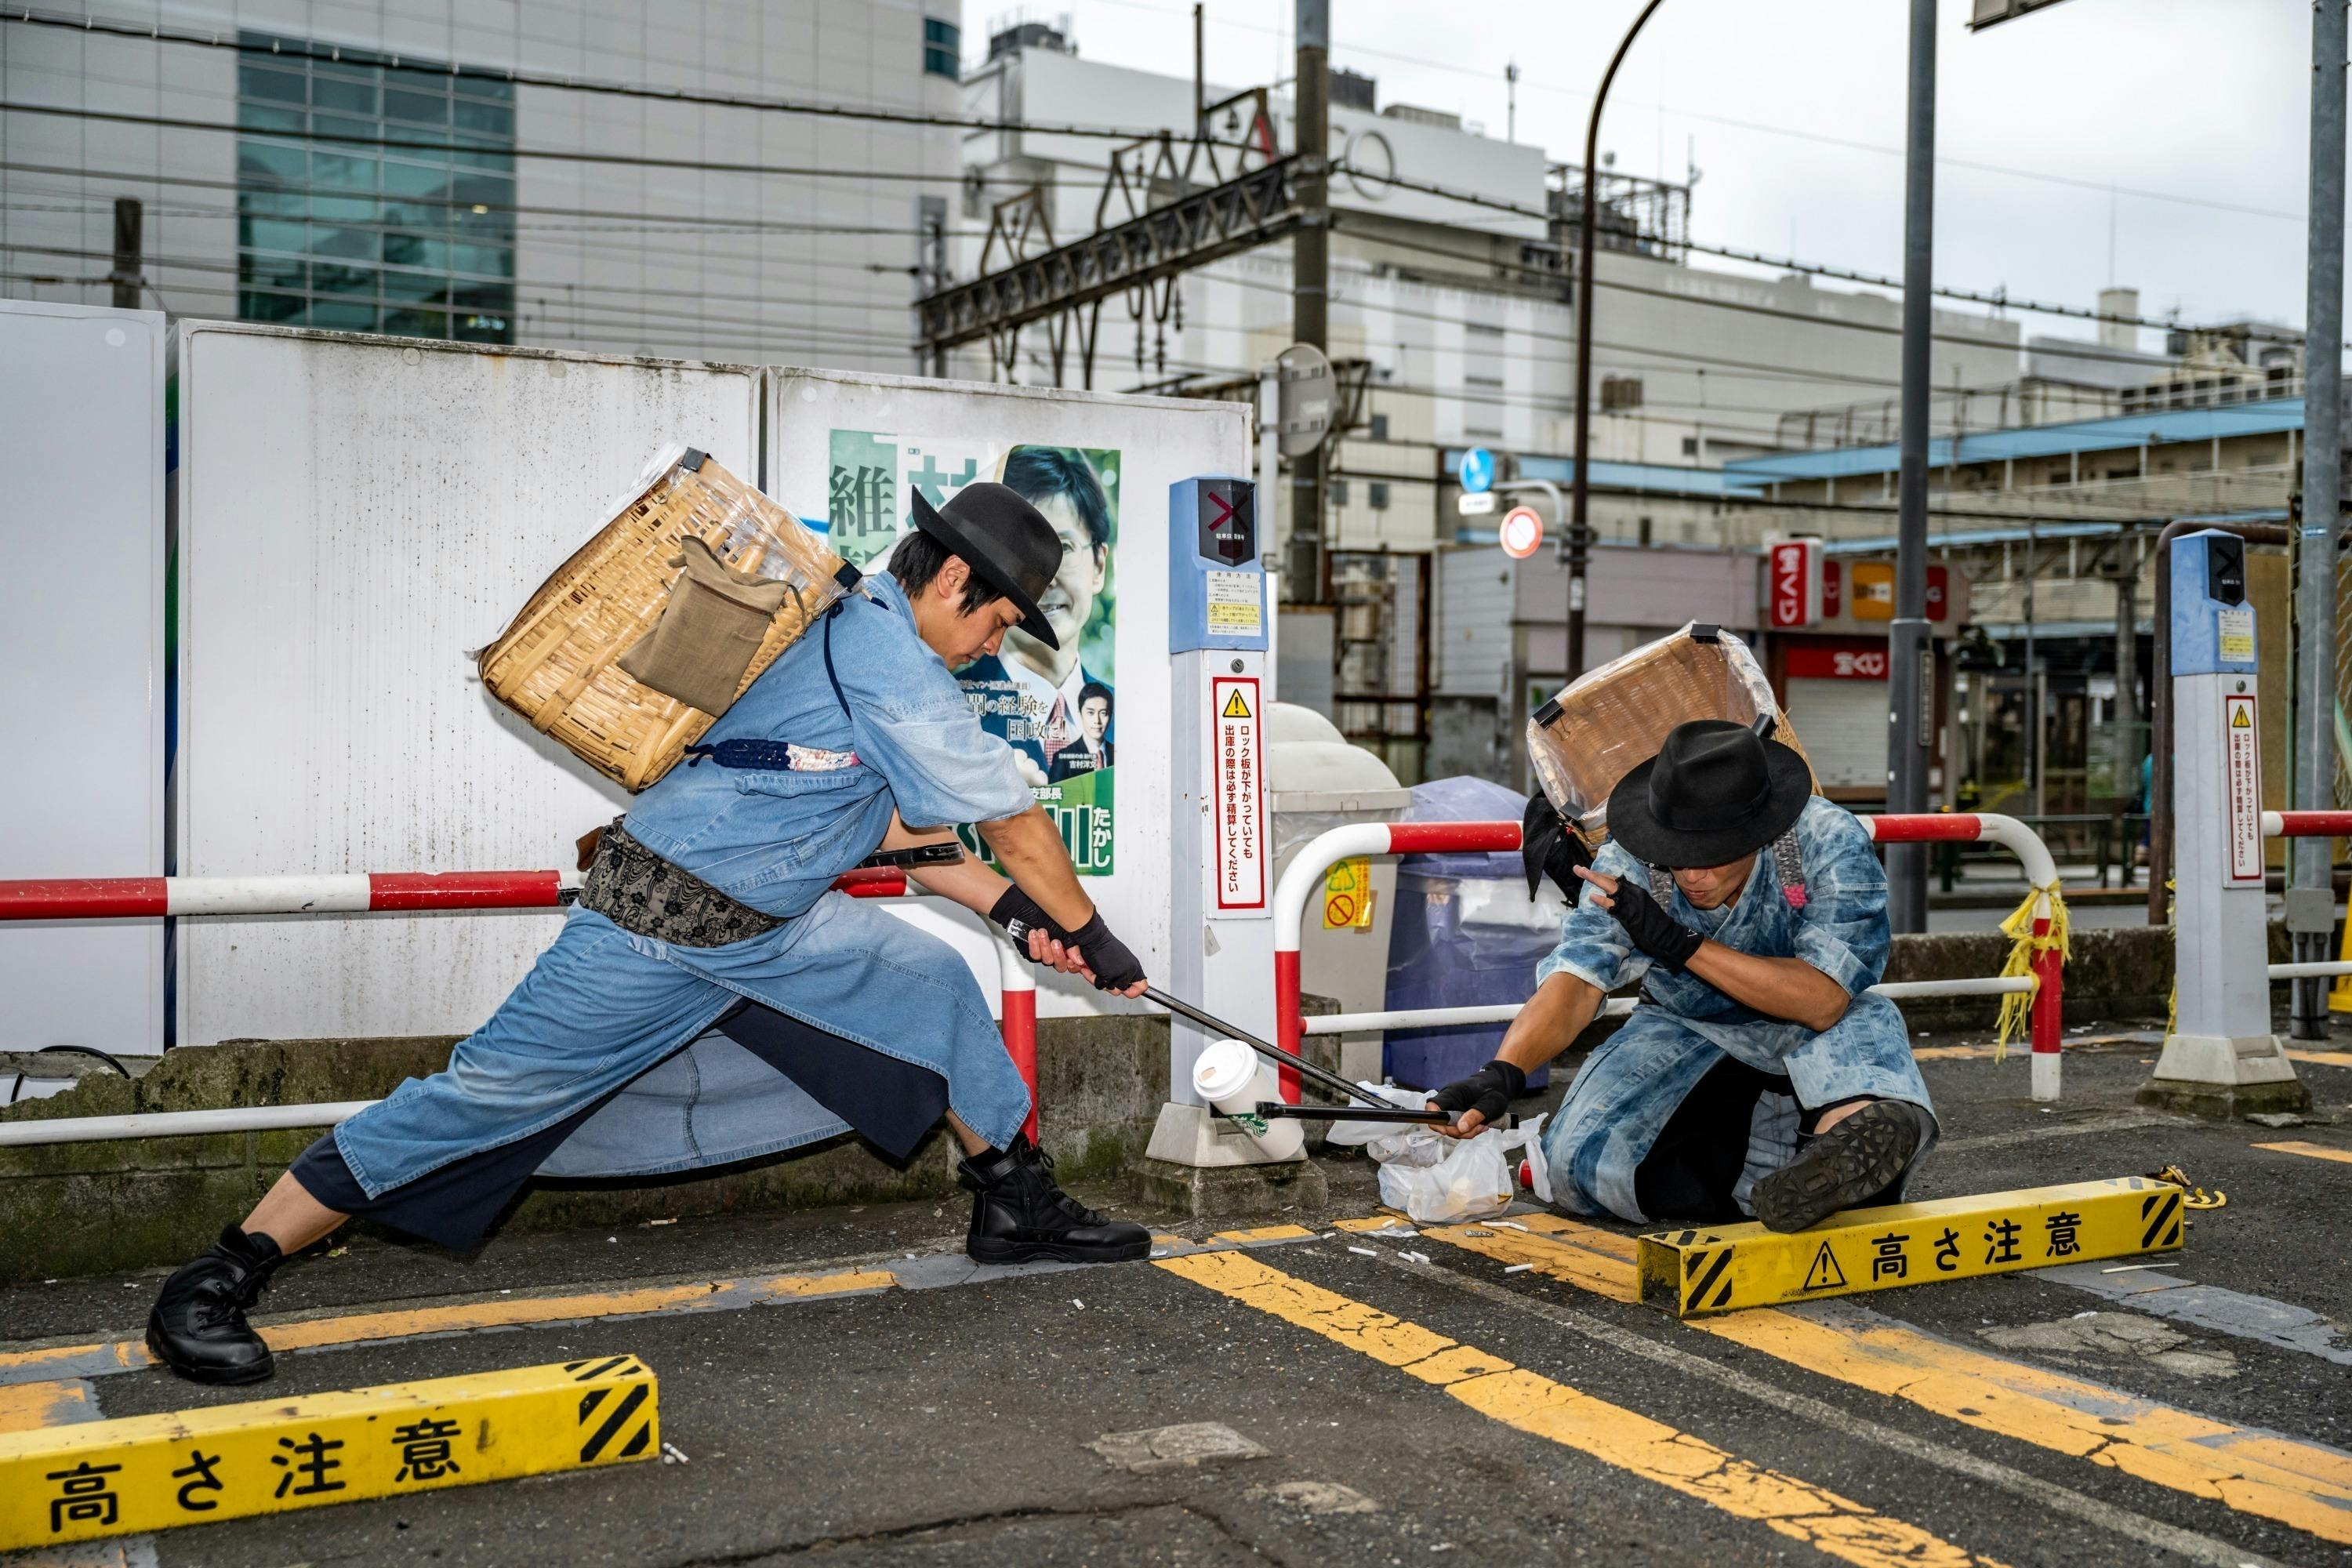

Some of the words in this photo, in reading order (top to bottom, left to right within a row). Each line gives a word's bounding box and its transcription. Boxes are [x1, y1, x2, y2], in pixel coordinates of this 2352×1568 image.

[1833, 652, 1884, 676] 宝くじ
[1092, 807, 1112, 868] たかし
[1225, 724, 1239, 893] 出庫の際は必ず精算してください
[1240, 725, 1253, 859] ロック板が下がっていても
[1871, 1211, 2082, 1282] 高さ注意
[45, 1417, 463, 1534] 高さ注意
